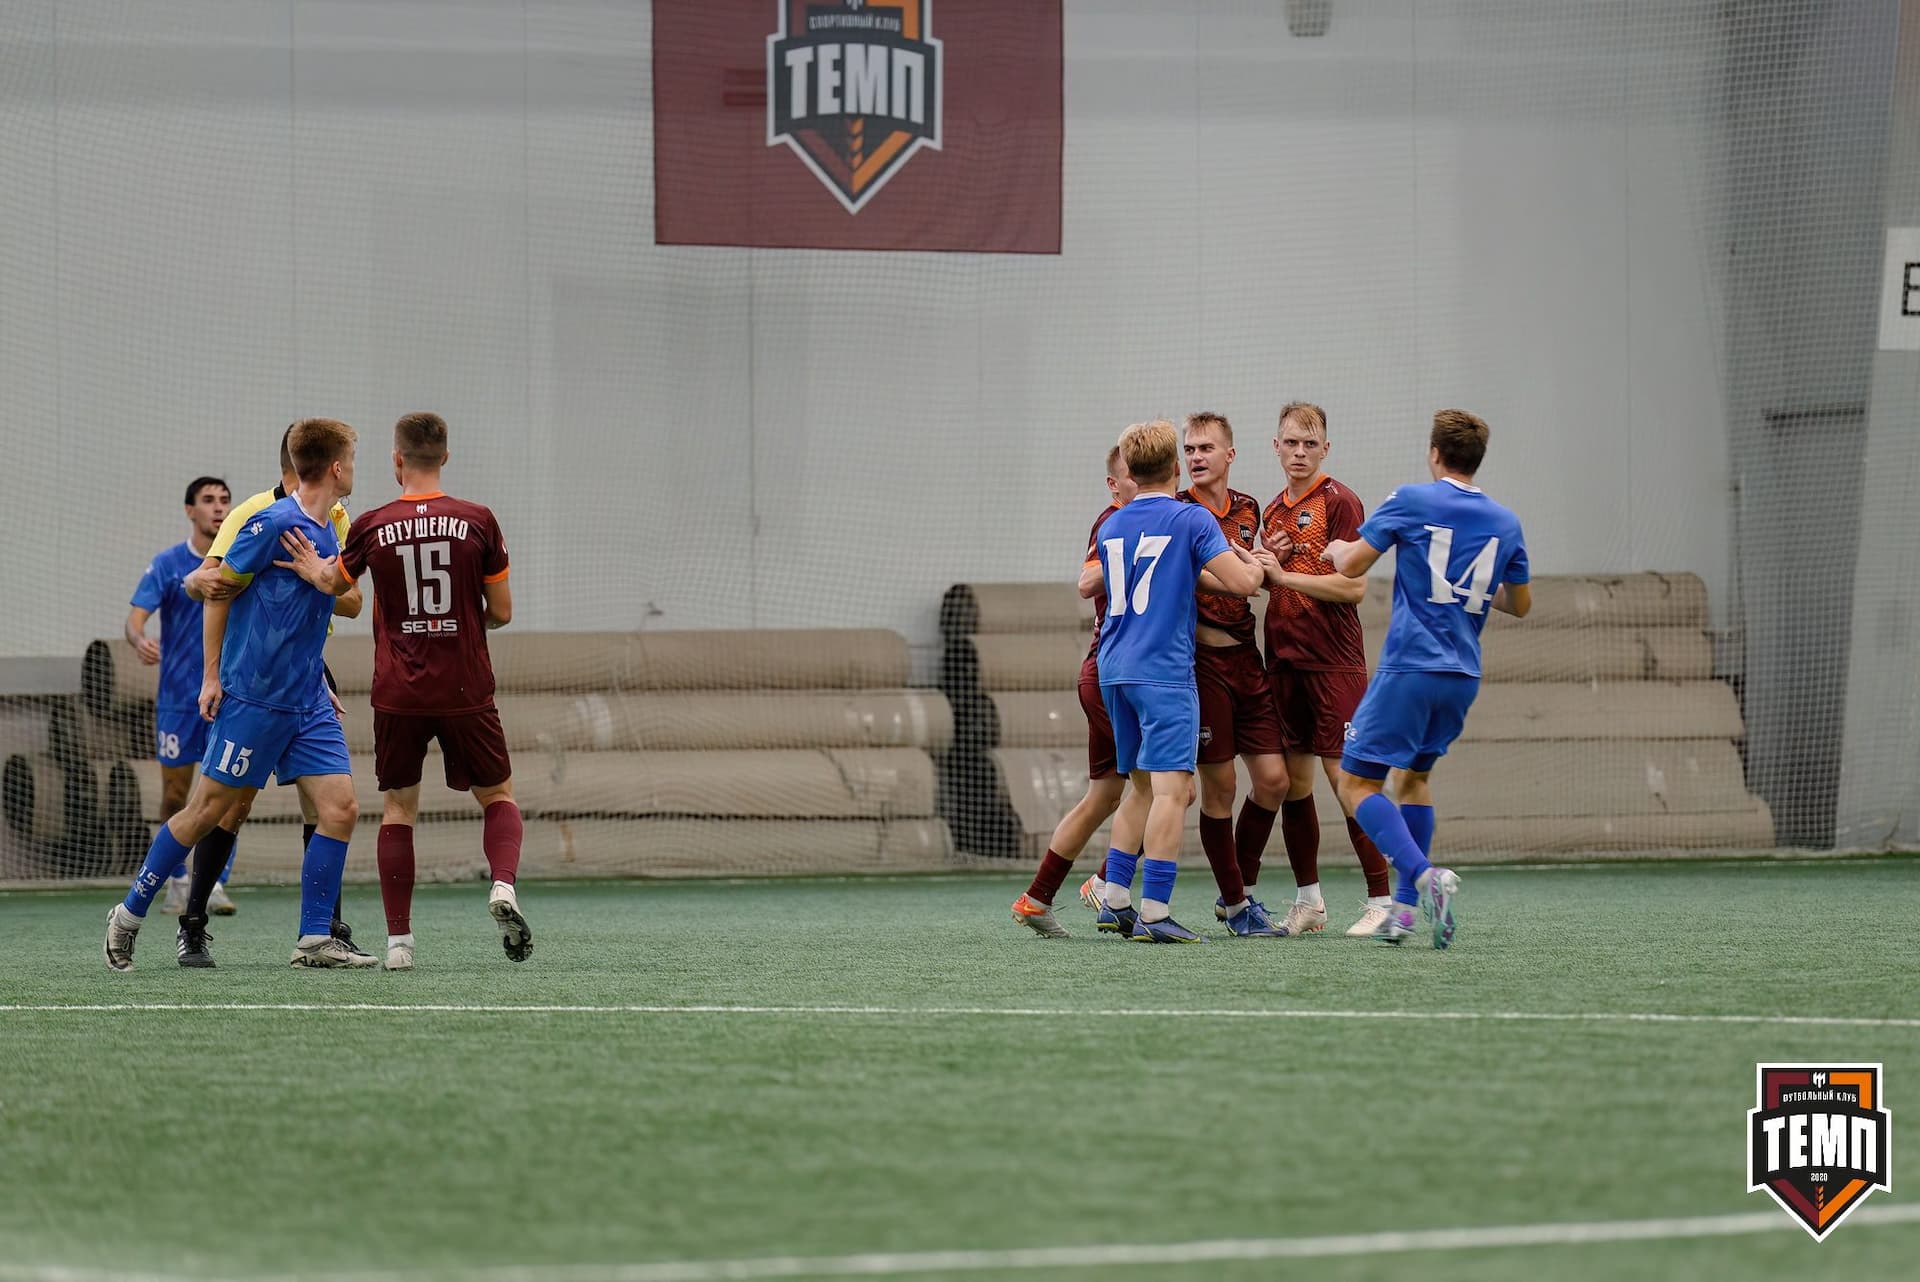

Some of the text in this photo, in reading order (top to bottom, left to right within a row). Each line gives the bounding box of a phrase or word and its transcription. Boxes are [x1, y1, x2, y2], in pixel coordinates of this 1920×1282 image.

[785, 43, 925, 124] ТЕМП
[377, 516, 469, 547] ЕВТУШЕНКО
[395, 541, 451, 615] 15
[1102, 532, 1173, 617] 17
[1423, 525, 1499, 615] 14
[401, 619, 458, 633] SEUS
[216, 739, 254, 777] 15
